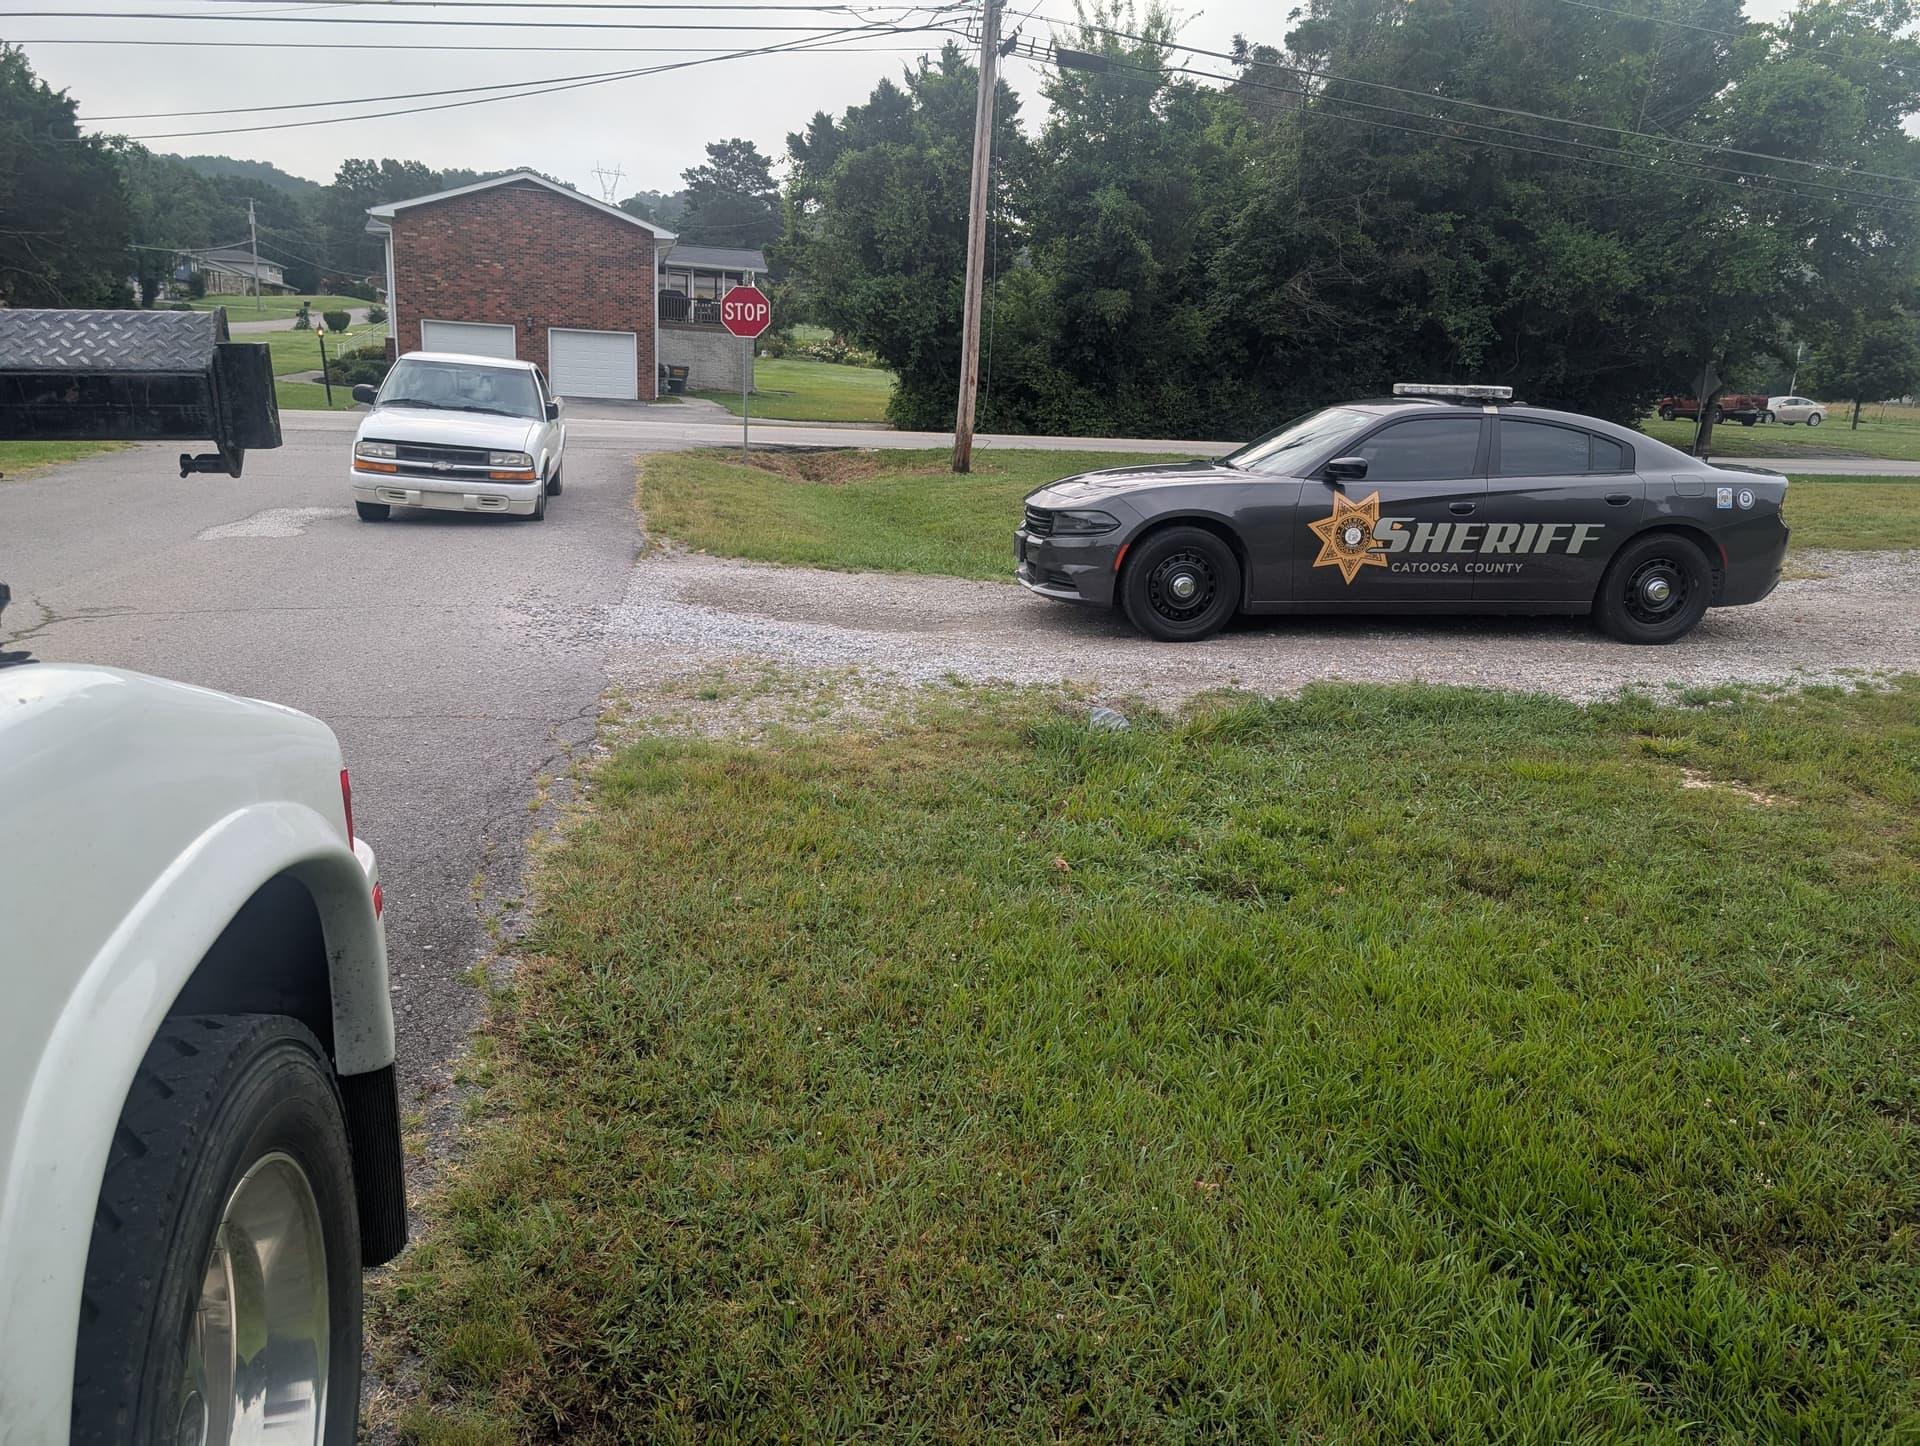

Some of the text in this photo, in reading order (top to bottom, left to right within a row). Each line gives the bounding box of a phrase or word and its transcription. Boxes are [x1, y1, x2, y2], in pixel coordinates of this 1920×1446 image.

[724, 302, 767, 322] STOP
[1366, 517, 1606, 554] SHERIFF
[1391, 562, 1524, 573] CATOOSA COUNTY
